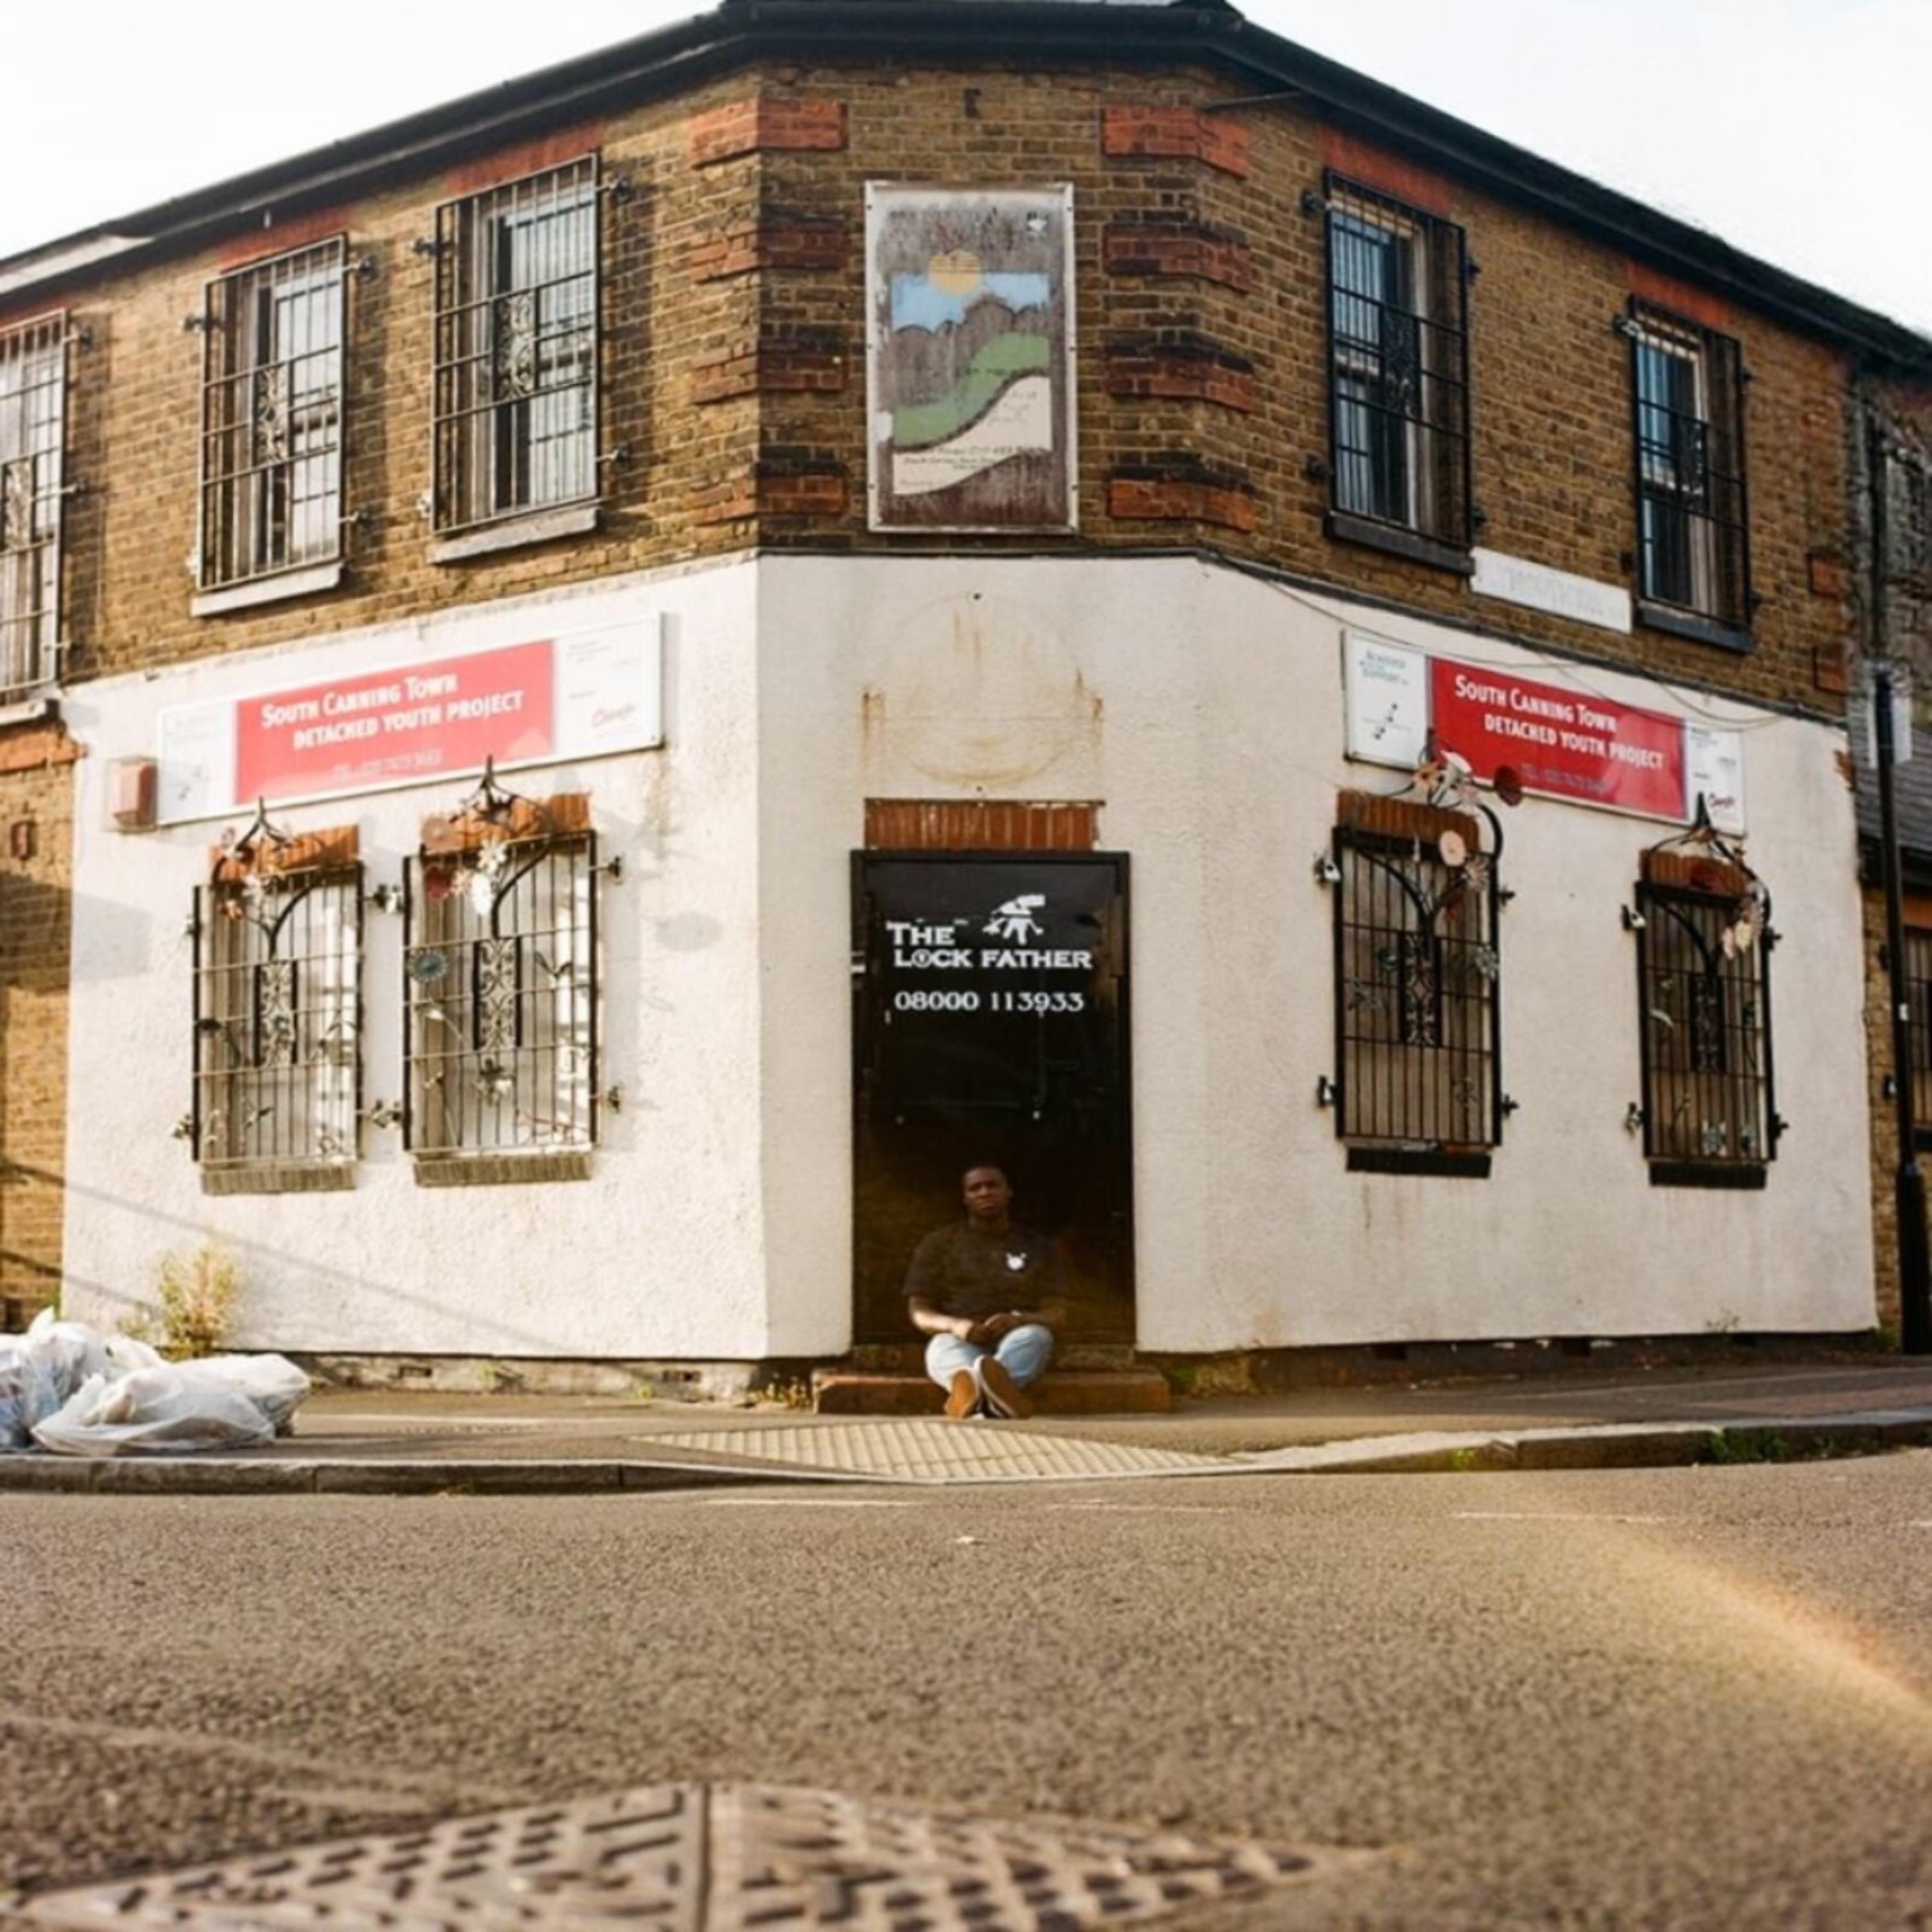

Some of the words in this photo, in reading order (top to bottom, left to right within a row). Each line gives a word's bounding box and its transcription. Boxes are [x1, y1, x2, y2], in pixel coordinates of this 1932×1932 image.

[262, 700, 319, 728] SOUTH
[323, 684, 401, 715] CANNING
[405, 674, 458, 701] TOWN
[294, 717, 379, 750] DETACHED
[383, 705, 442, 733] YOUTH
[446, 690, 524, 721] PROJECT
[1455, 674, 1506, 706] SOUTH
[1510, 688, 1573, 723] CANNING
[1577, 704, 1617, 732] TOWN
[1484, 714, 1557, 745] DETACHED
[1560, 730, 1605, 757] YOUTH
[1609, 743, 1663, 769] PROJECT
[886, 920, 955, 946] THE
[893, 949, 973, 969] LOCK
[981, 949, 1093, 970] FATHER
[895, 991, 980, 1012] 08000
[990, 991, 1084, 1012] 113933
